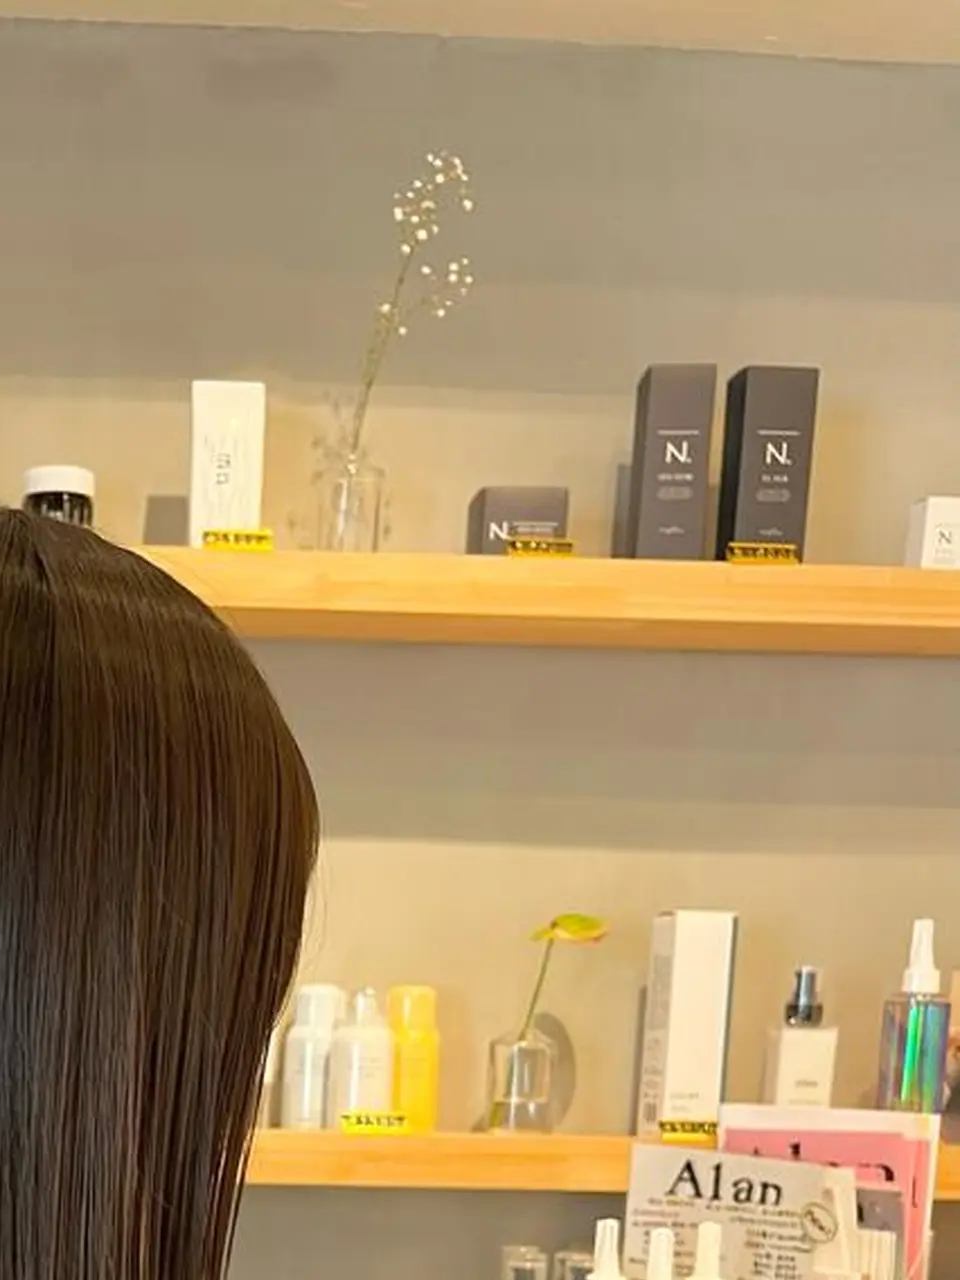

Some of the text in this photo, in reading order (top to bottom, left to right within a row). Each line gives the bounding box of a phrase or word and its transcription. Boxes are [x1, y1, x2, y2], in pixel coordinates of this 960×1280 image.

[665, 440, 692, 465] N.
[765, 441, 792, 466] N.
[664, 1158, 783, 1207] Alan
